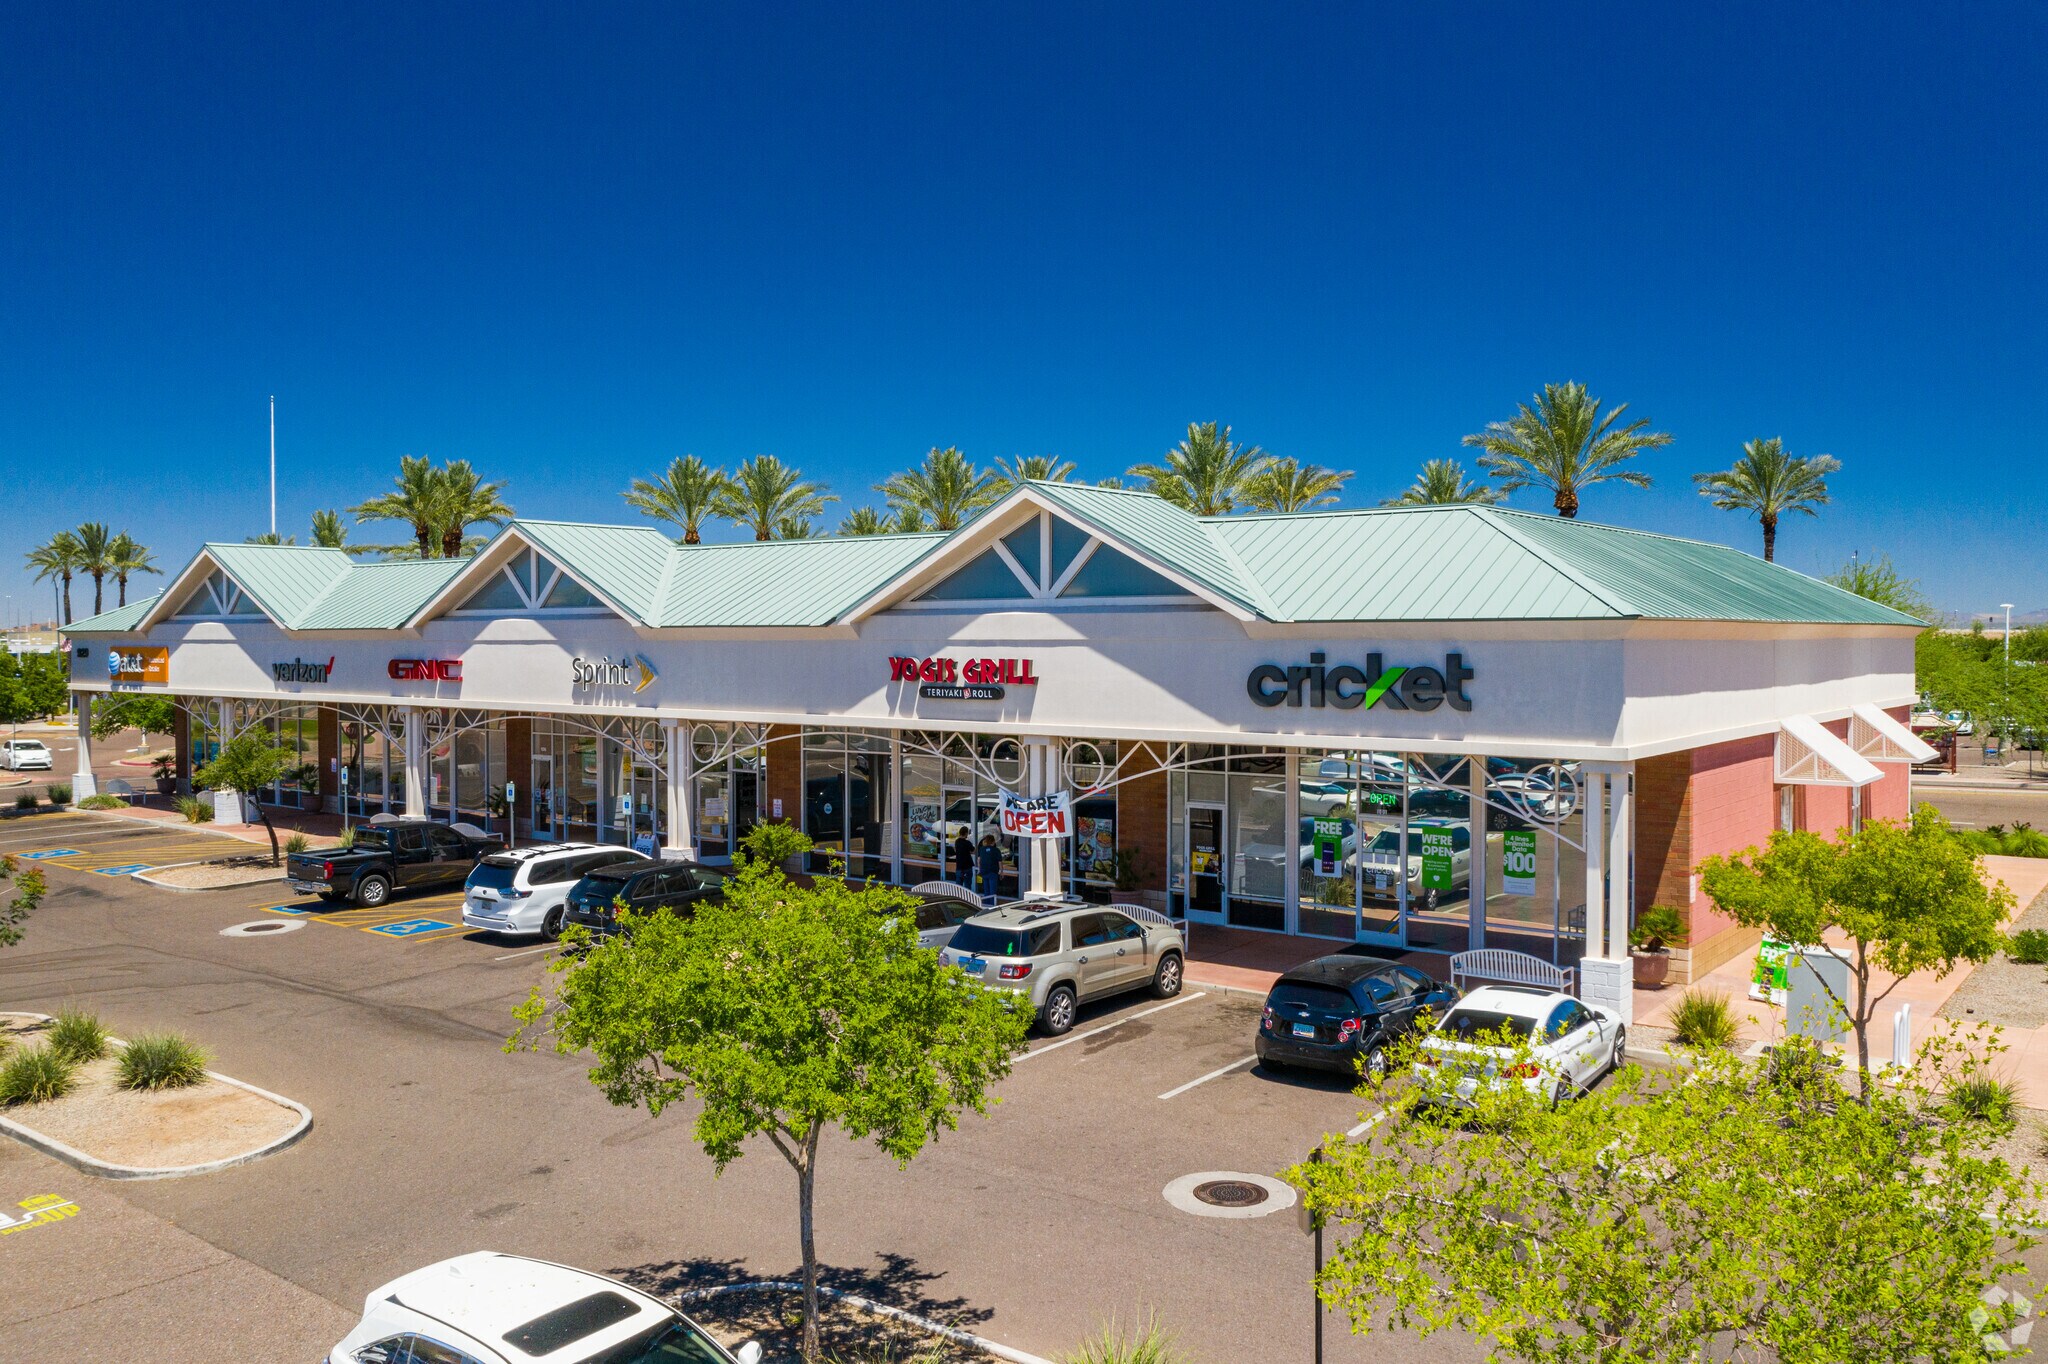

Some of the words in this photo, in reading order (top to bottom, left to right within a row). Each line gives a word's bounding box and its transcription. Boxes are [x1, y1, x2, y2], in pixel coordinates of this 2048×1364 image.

[120, 653, 145, 673] at&t
[272, 657, 328, 683] verizon
[388, 658, 463, 681] GNC
[888, 656, 957, 683] YOGIS
[962, 658, 1038, 685] GRILL
[572, 656, 630, 692] Sprint
[1247, 652, 1474, 712] cricket
[926, 687, 963, 698] TERIYAKI
[972, 688, 994, 699] ROLL
[1026, 795, 1059, 812] ARE
[1370, 792, 1396, 805] OPEN
[910, 810, 937, 823] SPECIAL
[912, 805, 932, 816] LUNCH
[1004, 809, 1066, 834] OPEN
[1313, 820, 1342, 836] FREE
[1421, 833, 1453, 846] WE'RE
[1504, 840, 1535, 848] Unlimited
[1421, 844, 1453, 858] OPEN
[1503, 851, 1536, 874] $100
